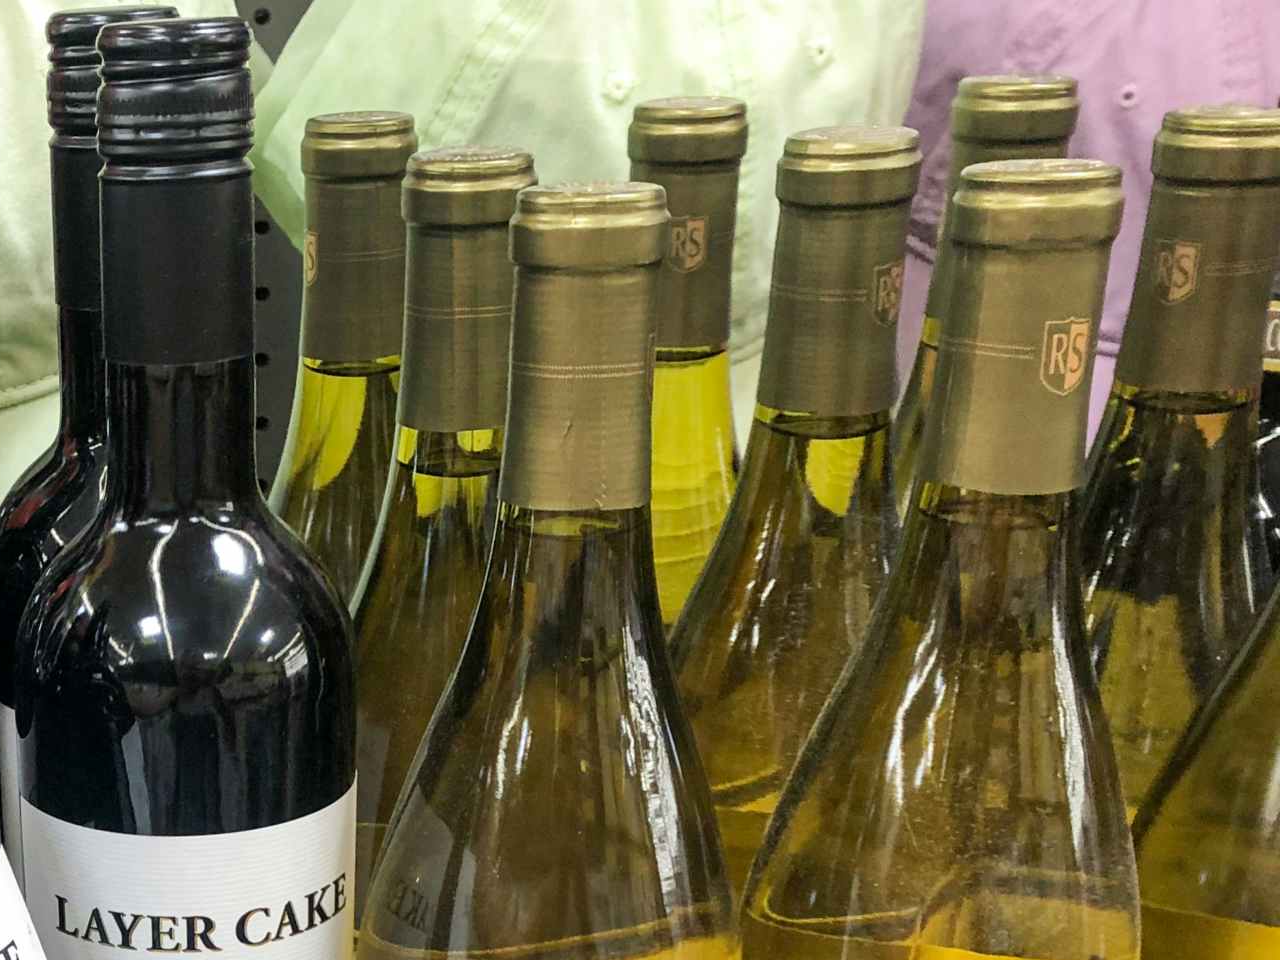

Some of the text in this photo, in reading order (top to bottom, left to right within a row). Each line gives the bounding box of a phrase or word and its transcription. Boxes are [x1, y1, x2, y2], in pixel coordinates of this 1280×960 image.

[1047, 331, 1089, 375] RS
[55, 894, 223, 953] LAYER
[234, 872, 348, 947] CAKE
